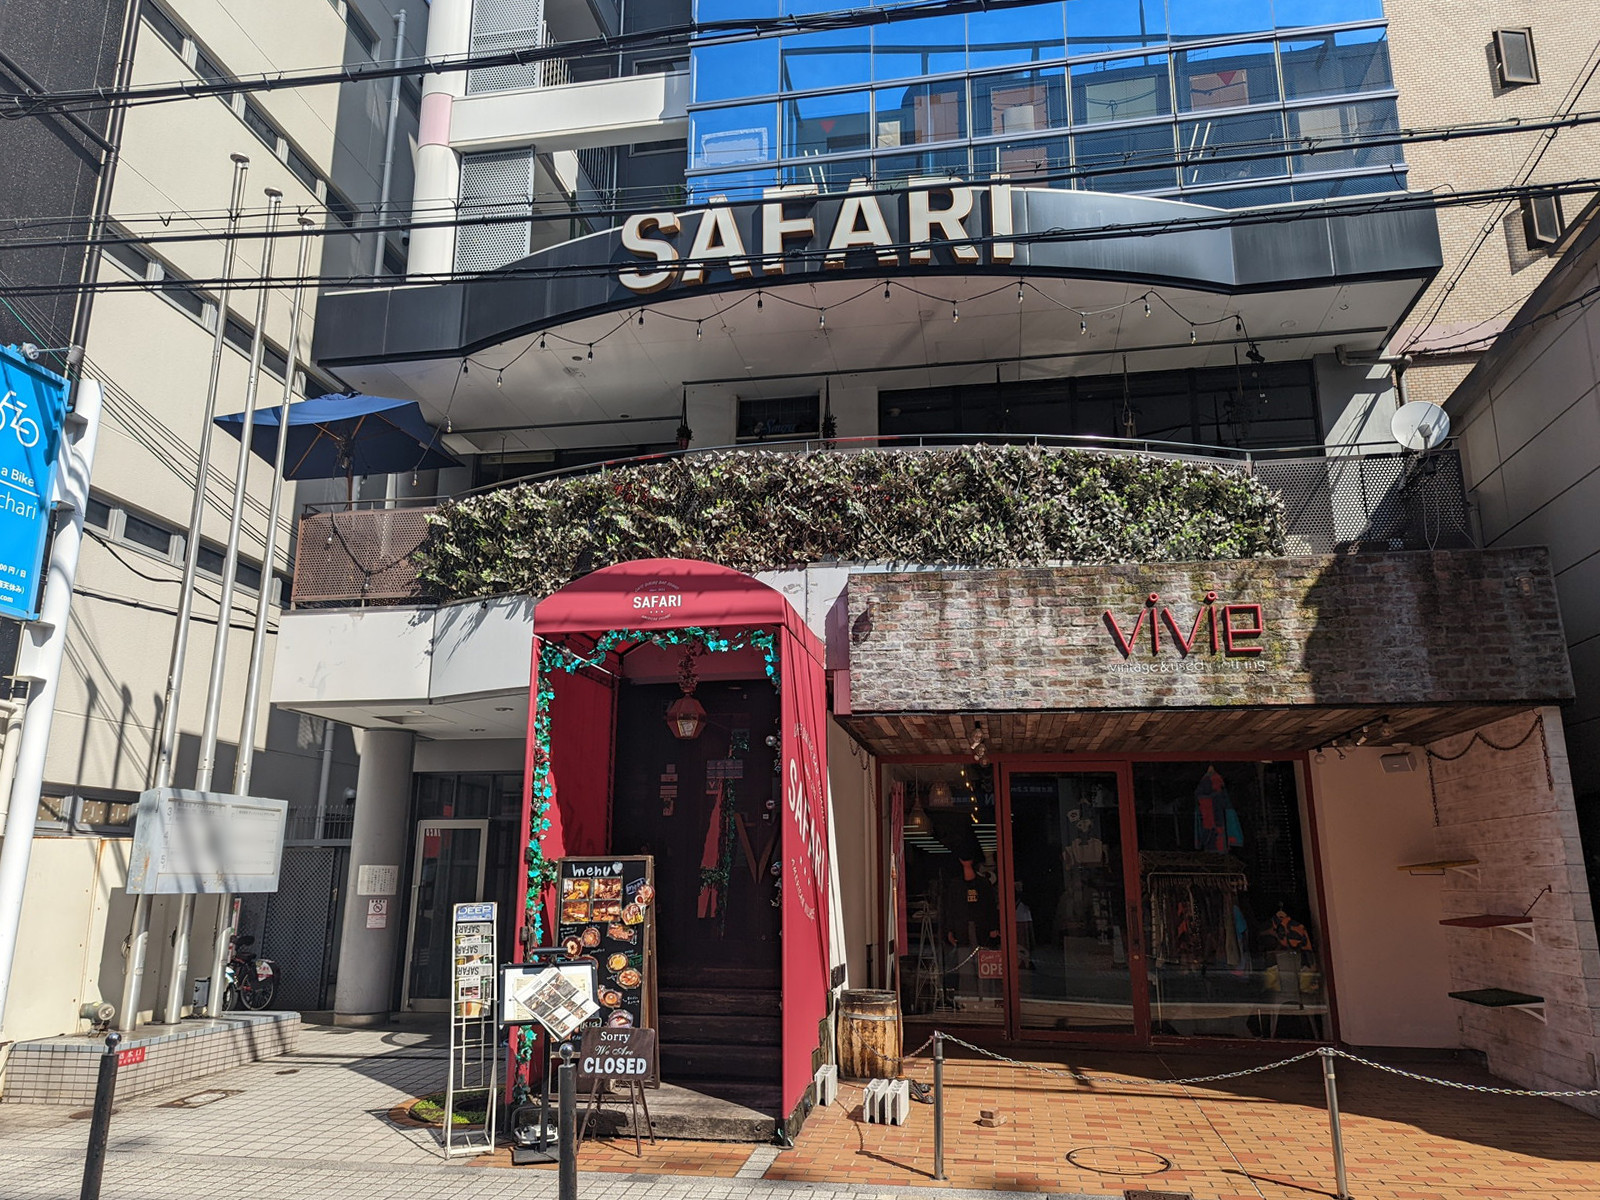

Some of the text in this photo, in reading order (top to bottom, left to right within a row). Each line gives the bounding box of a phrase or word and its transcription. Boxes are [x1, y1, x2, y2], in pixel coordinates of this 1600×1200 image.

[618, 174, 1015, 294] SAFARI
[11, 468, 35, 487] Bike
[633, 594, 682, 609] SAFARI
[788, 758, 825, 894] SAFARI
[572, 863, 611, 876] menu
[458, 905, 492, 915] DEEP
[600, 1031, 631, 1043] Sorry
[594, 1045, 634, 1056] We Are
[583, 1057, 647, 1074] CLOSED
